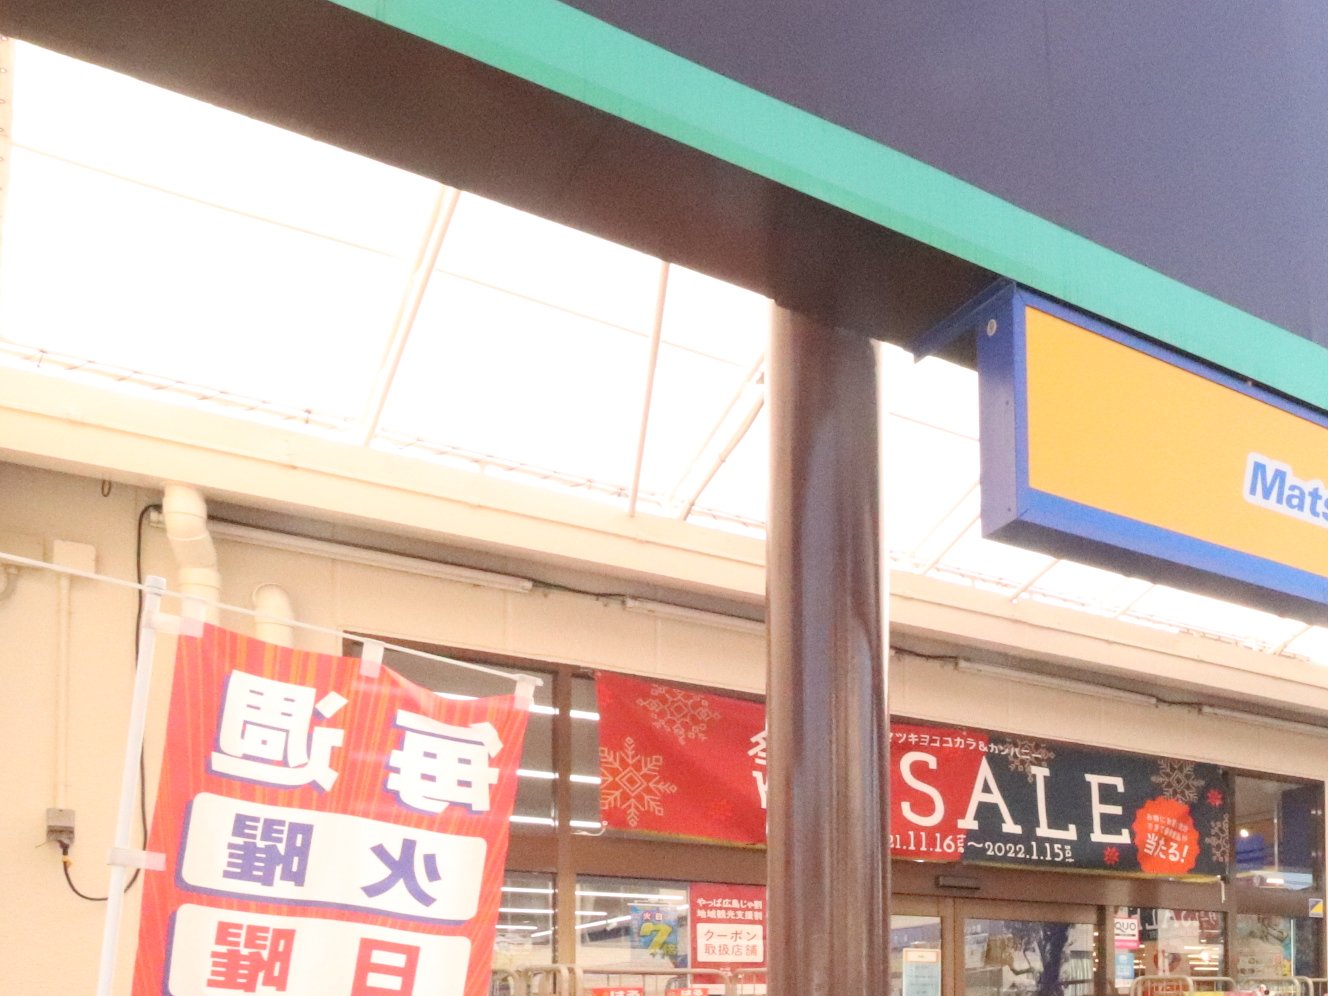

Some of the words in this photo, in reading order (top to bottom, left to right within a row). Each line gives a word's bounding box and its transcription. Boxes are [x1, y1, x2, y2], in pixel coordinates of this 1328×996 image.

[900, 751, 1132, 844] SALE
[697, 898, 763, 909] やっぱ広島じゃ割
[697, 910, 763, 920] 地域観光支援割
[1115, 922, 1137, 934] QUO
[704, 930, 757, 942] クーポン
[704, 944, 757, 956] 取扱店舗
